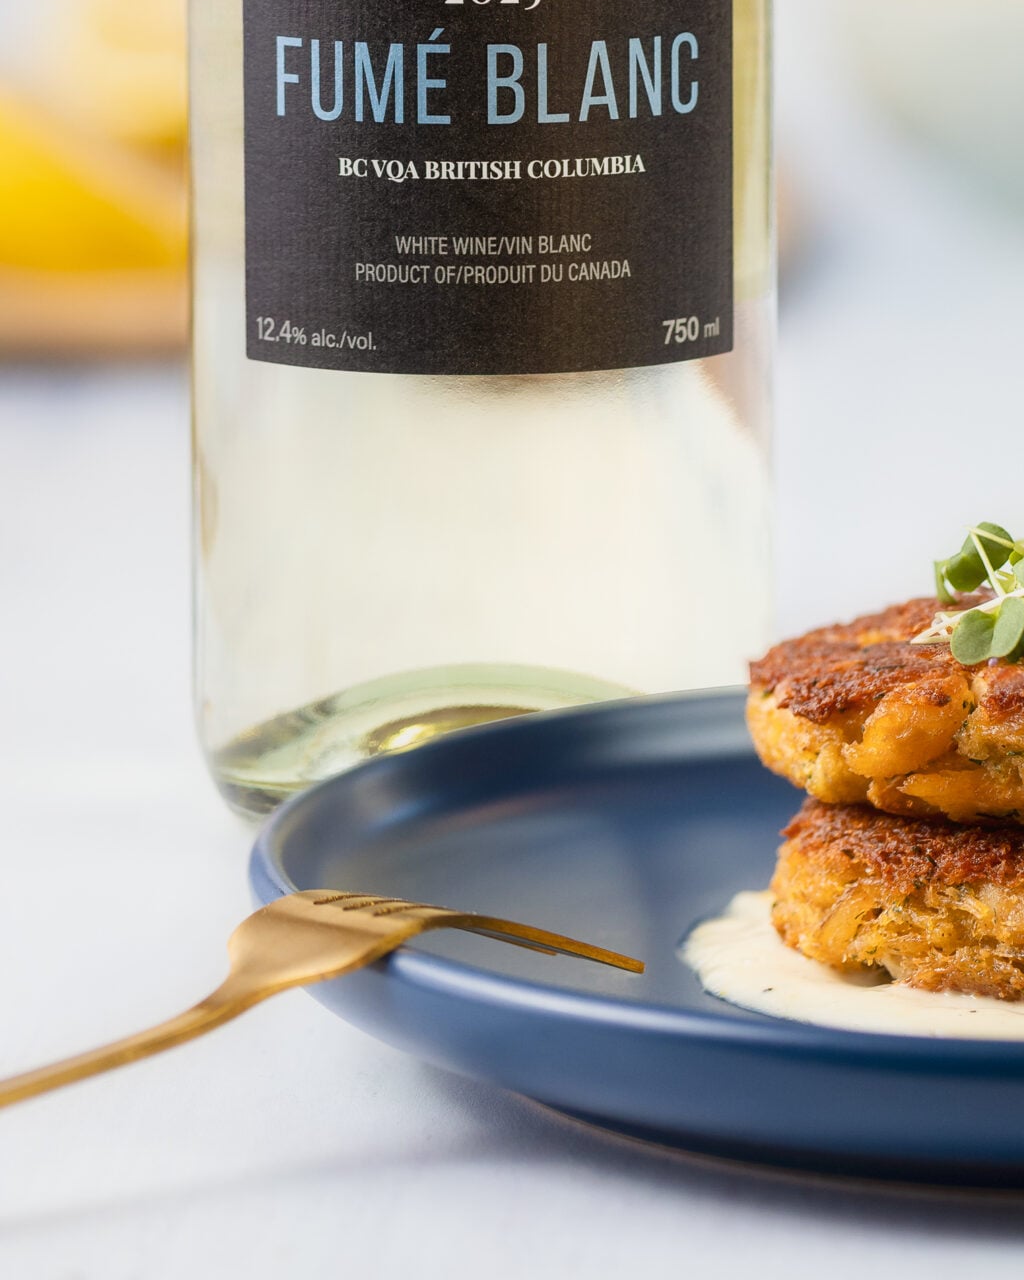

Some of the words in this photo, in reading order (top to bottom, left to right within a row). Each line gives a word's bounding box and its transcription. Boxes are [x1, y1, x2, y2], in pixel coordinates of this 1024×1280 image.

[275, 27, 451, 125] FUMÉ
[487, 31, 699, 125] BLANC
[338, 157, 368, 178] BC
[370, 159, 420, 183] VQA
[424, 160, 522, 180] BRITISH
[527, 154, 646, 179] COLUMBIA
[394, 235, 449, 255] WHITE
[452, 235, 533, 256] WINE/VIN
[538, 233, 592, 254] BLANC
[355, 262, 431, 284] PRODUCT
[434, 264, 537, 284] OF/PRODUIT
[540, 263, 563, 283] DU
[568, 259, 632, 282] CANADA
[255, 316, 307, 345] 12.4%
[310, 328, 377, 351] alc./vol.
[662, 315, 700, 345] 750
[703, 316, 720, 338] ml
